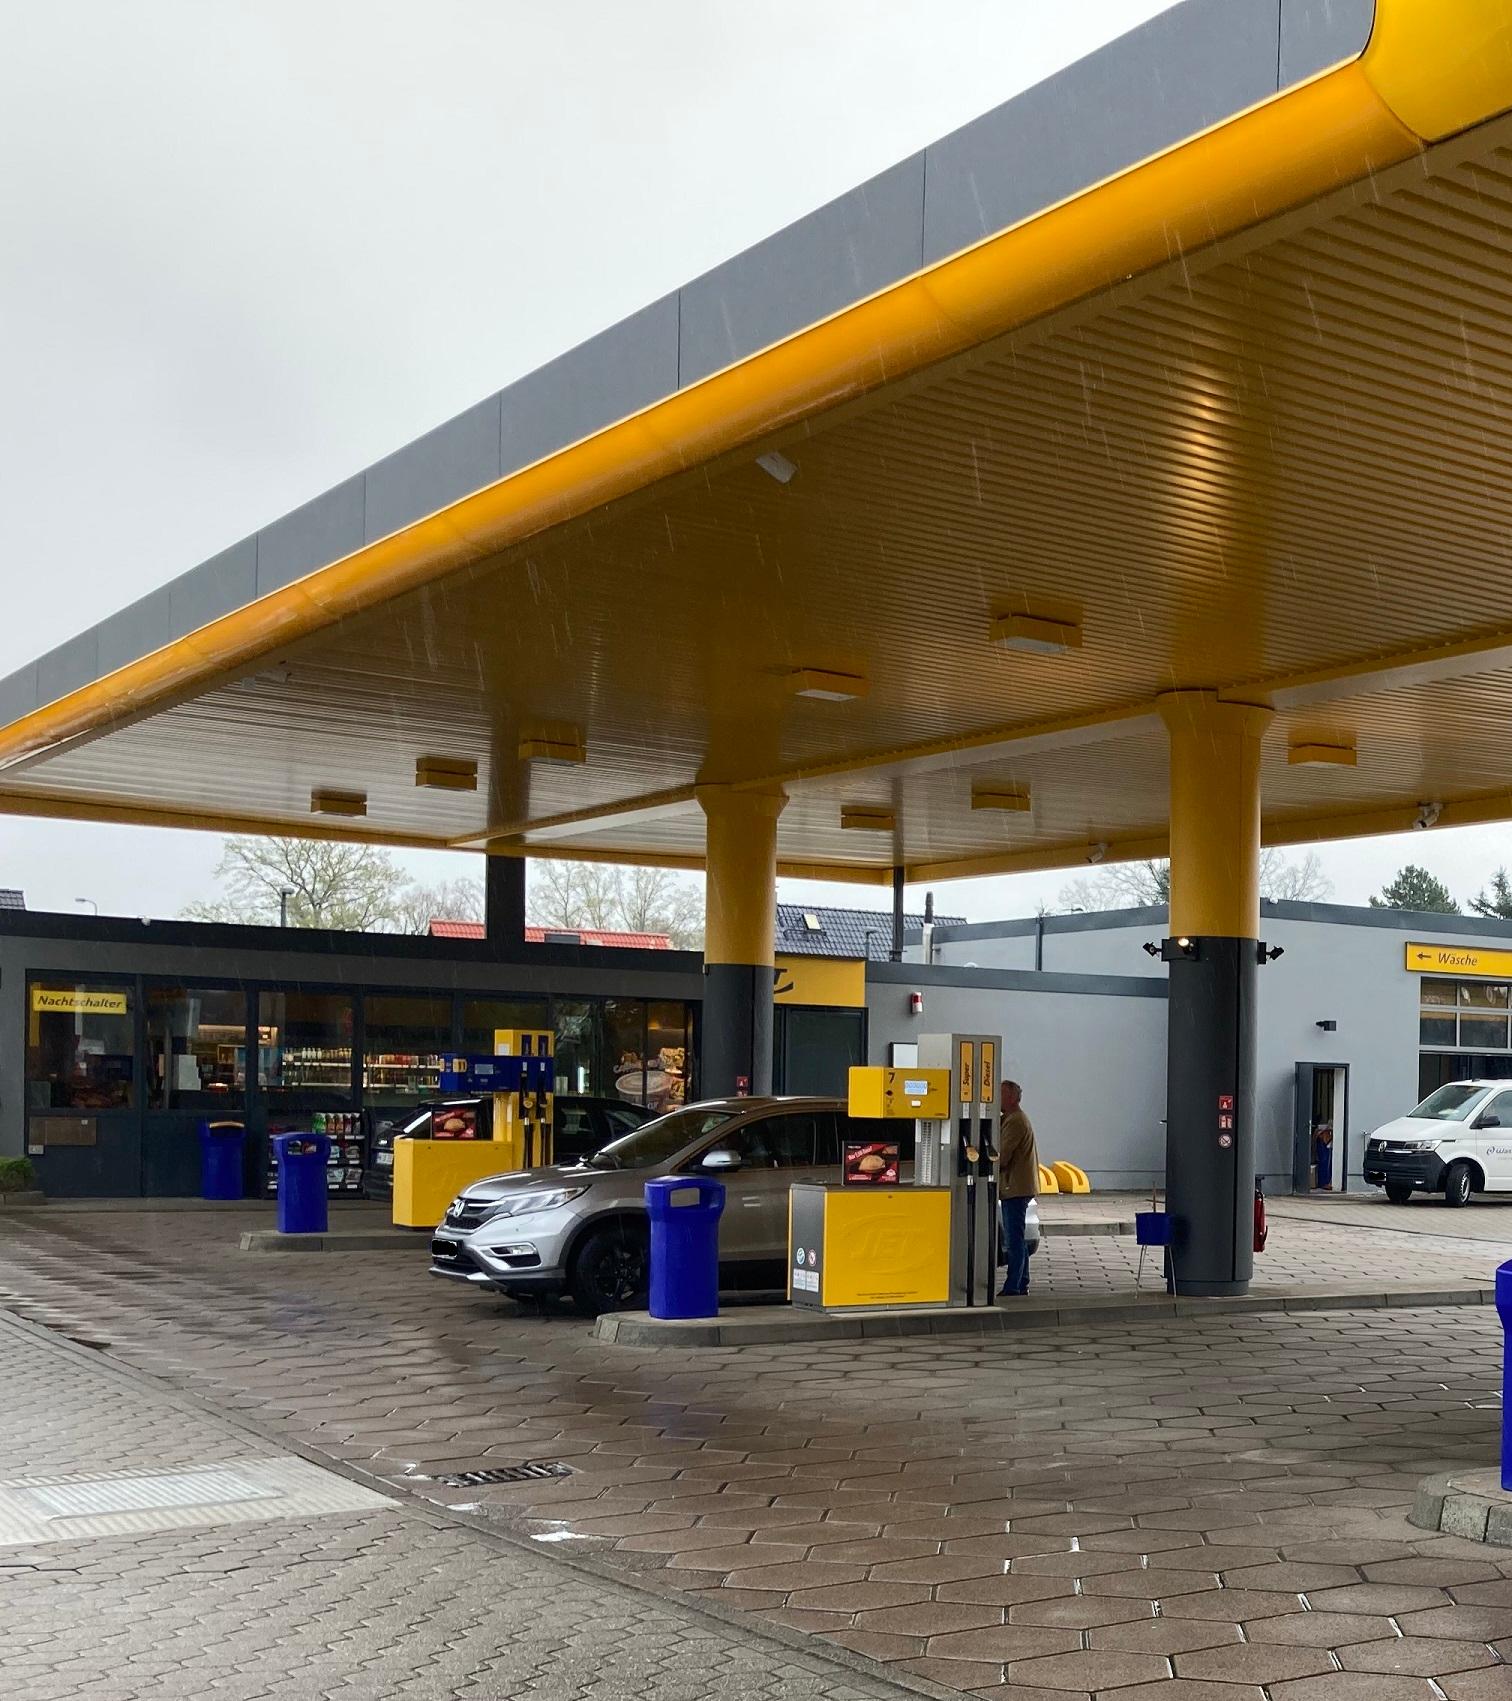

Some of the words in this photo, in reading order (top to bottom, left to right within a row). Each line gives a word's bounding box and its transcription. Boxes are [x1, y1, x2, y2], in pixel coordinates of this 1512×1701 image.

[1438, 952, 1478, 966] Wäsche
[37, 995, 122, 1009] Nachtschalter
[888, 1072, 895, 1084] 7
